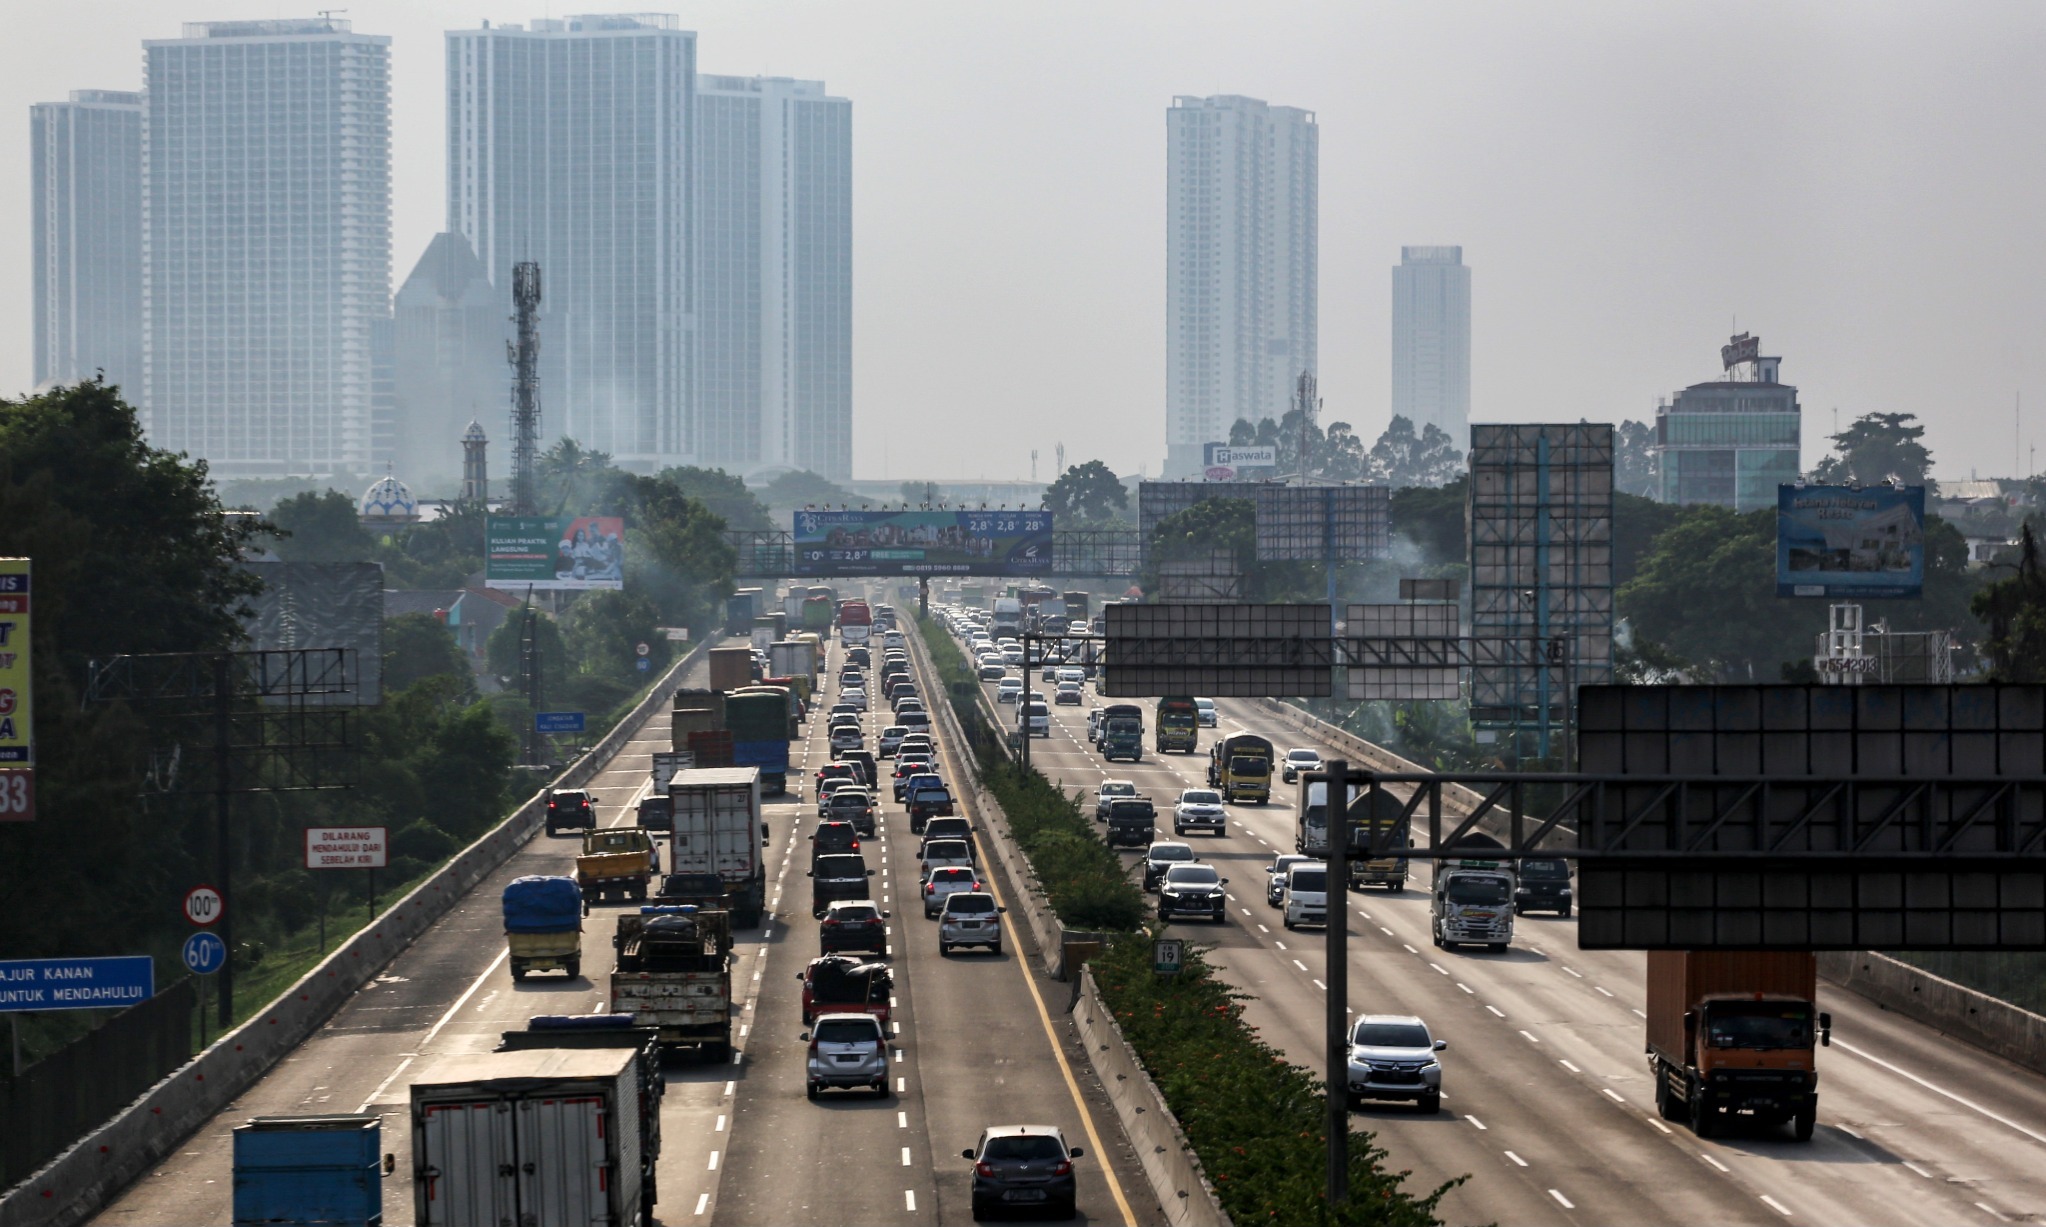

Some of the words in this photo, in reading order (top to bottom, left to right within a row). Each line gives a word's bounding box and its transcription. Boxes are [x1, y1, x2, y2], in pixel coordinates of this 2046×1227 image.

[322, 832, 370, 841] DILARANG
[312, 844, 360, 852] MENDAHULUI
[362, 843, 382, 852] DARI
[321, 855, 354, 864] SEBELAH
[357, 855, 373, 863] KIRI
[190, 896, 211, 916] 100
[188, 939, 210, 967] 60
[1162, 952, 1174, 962] 19
[44, 967, 93, 980] KANAN
[53, 985, 143, 1001] MENDAHULUI
